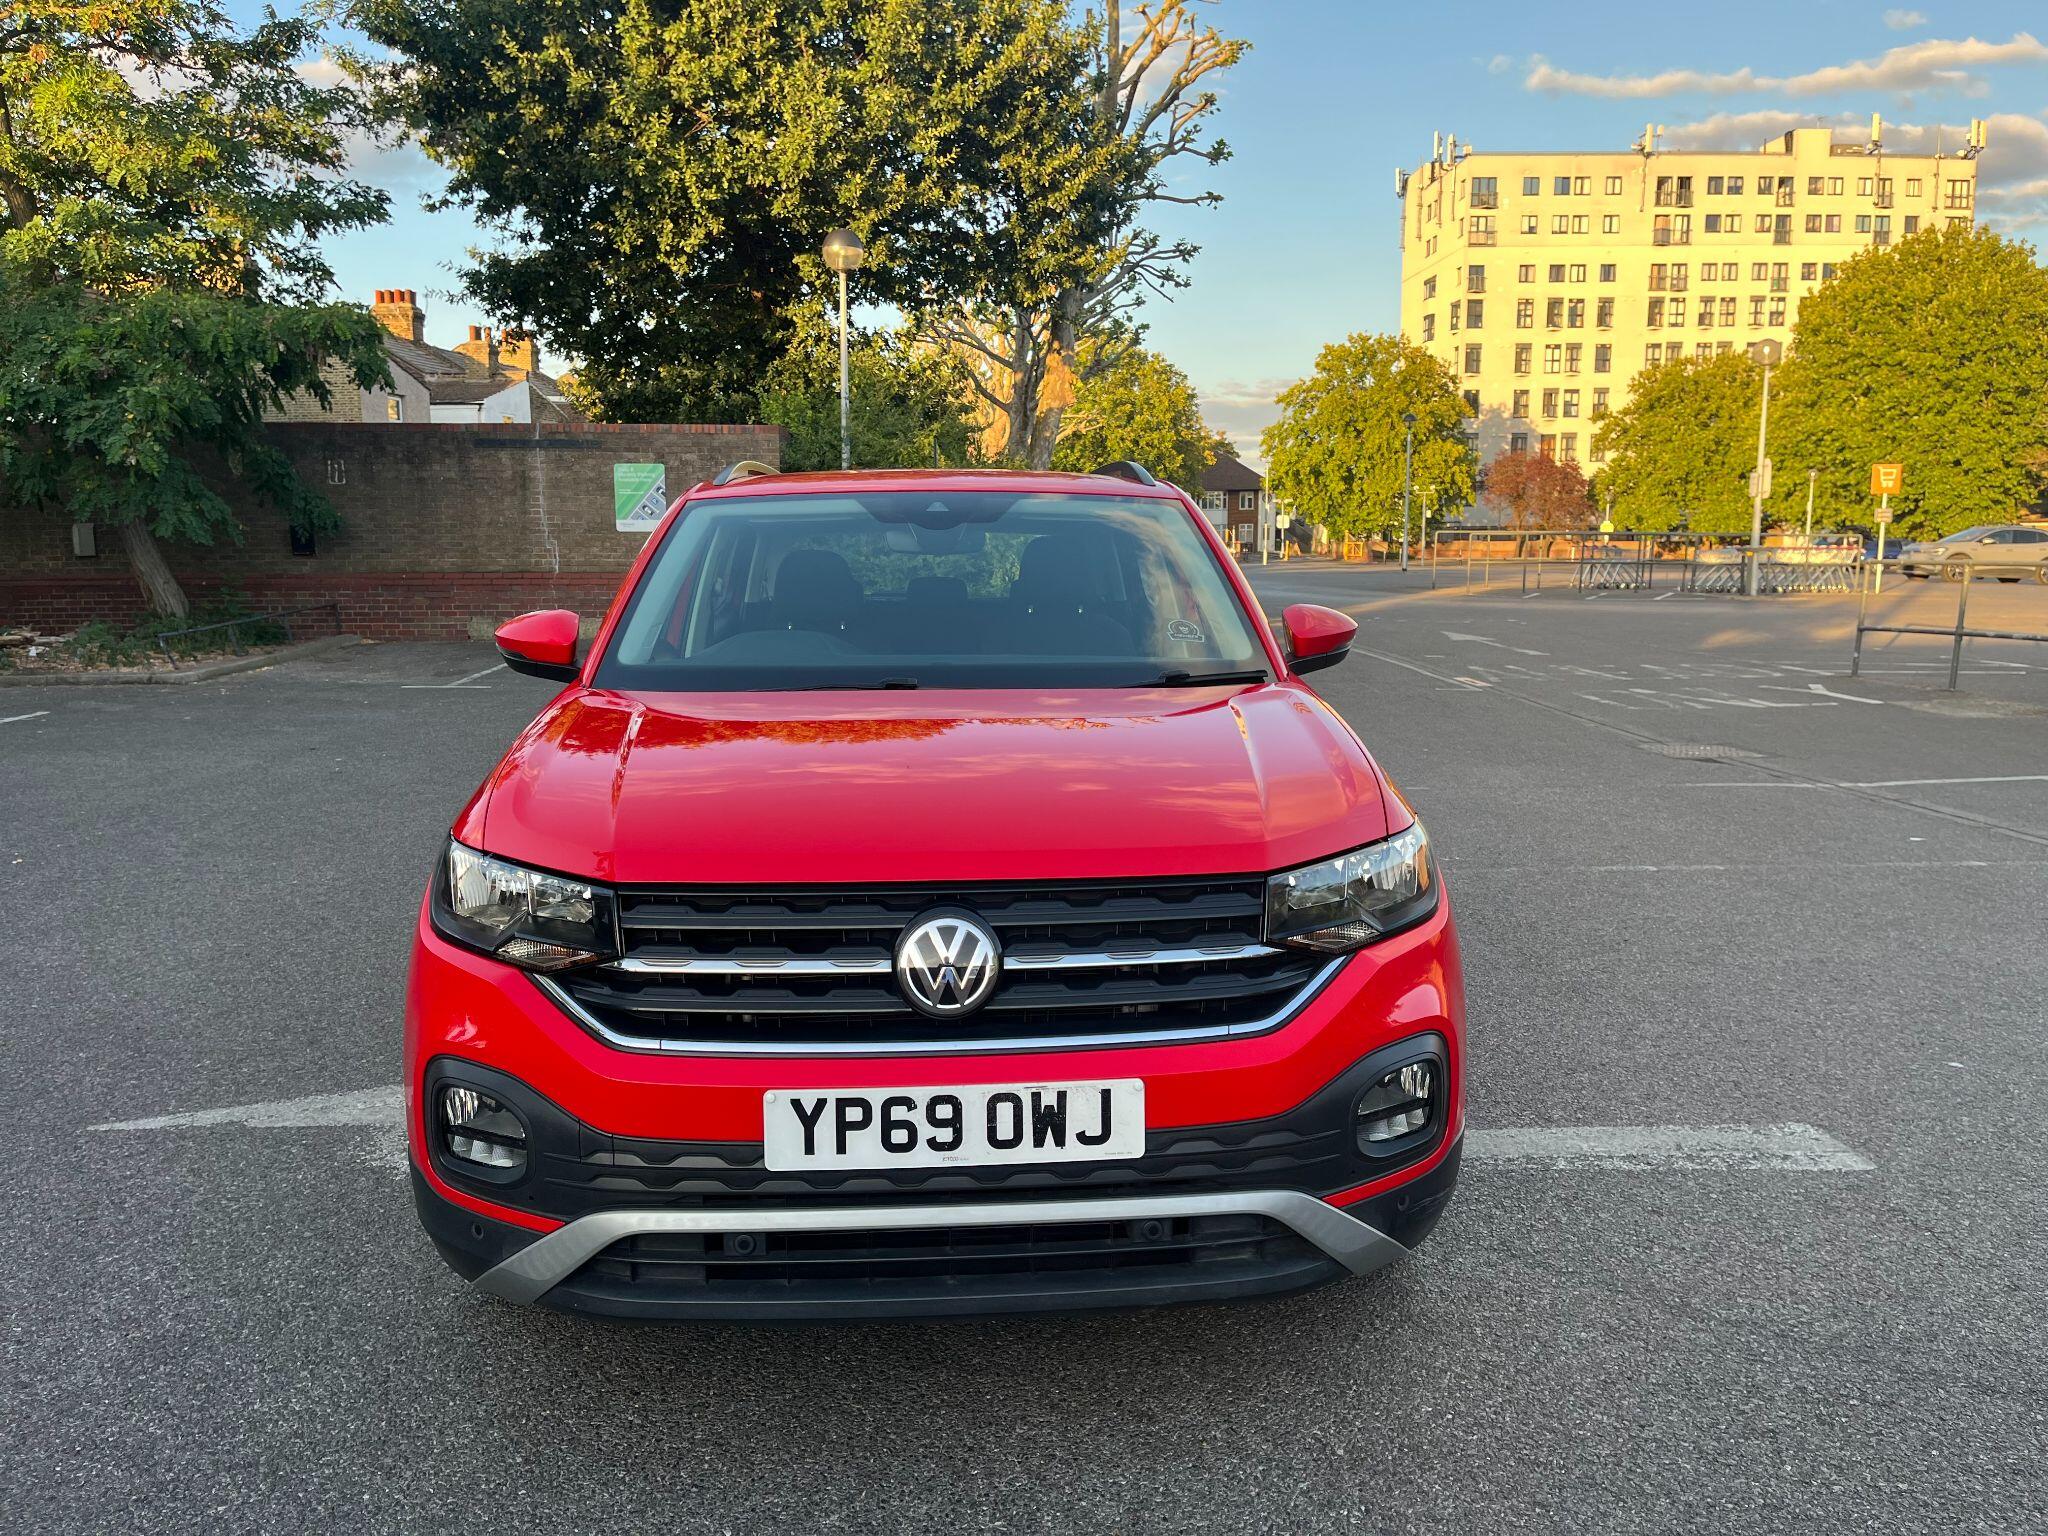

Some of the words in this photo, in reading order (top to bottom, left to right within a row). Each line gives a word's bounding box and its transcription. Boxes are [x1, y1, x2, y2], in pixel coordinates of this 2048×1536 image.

[1467, 663, 1784, 682] AHEAD
[1572, 684, 1885, 710] ONLY
[900, 918, 996, 1010] VW
[789, 1094, 964, 1155] YP69
[986, 1088, 1112, 1150] OWJ
